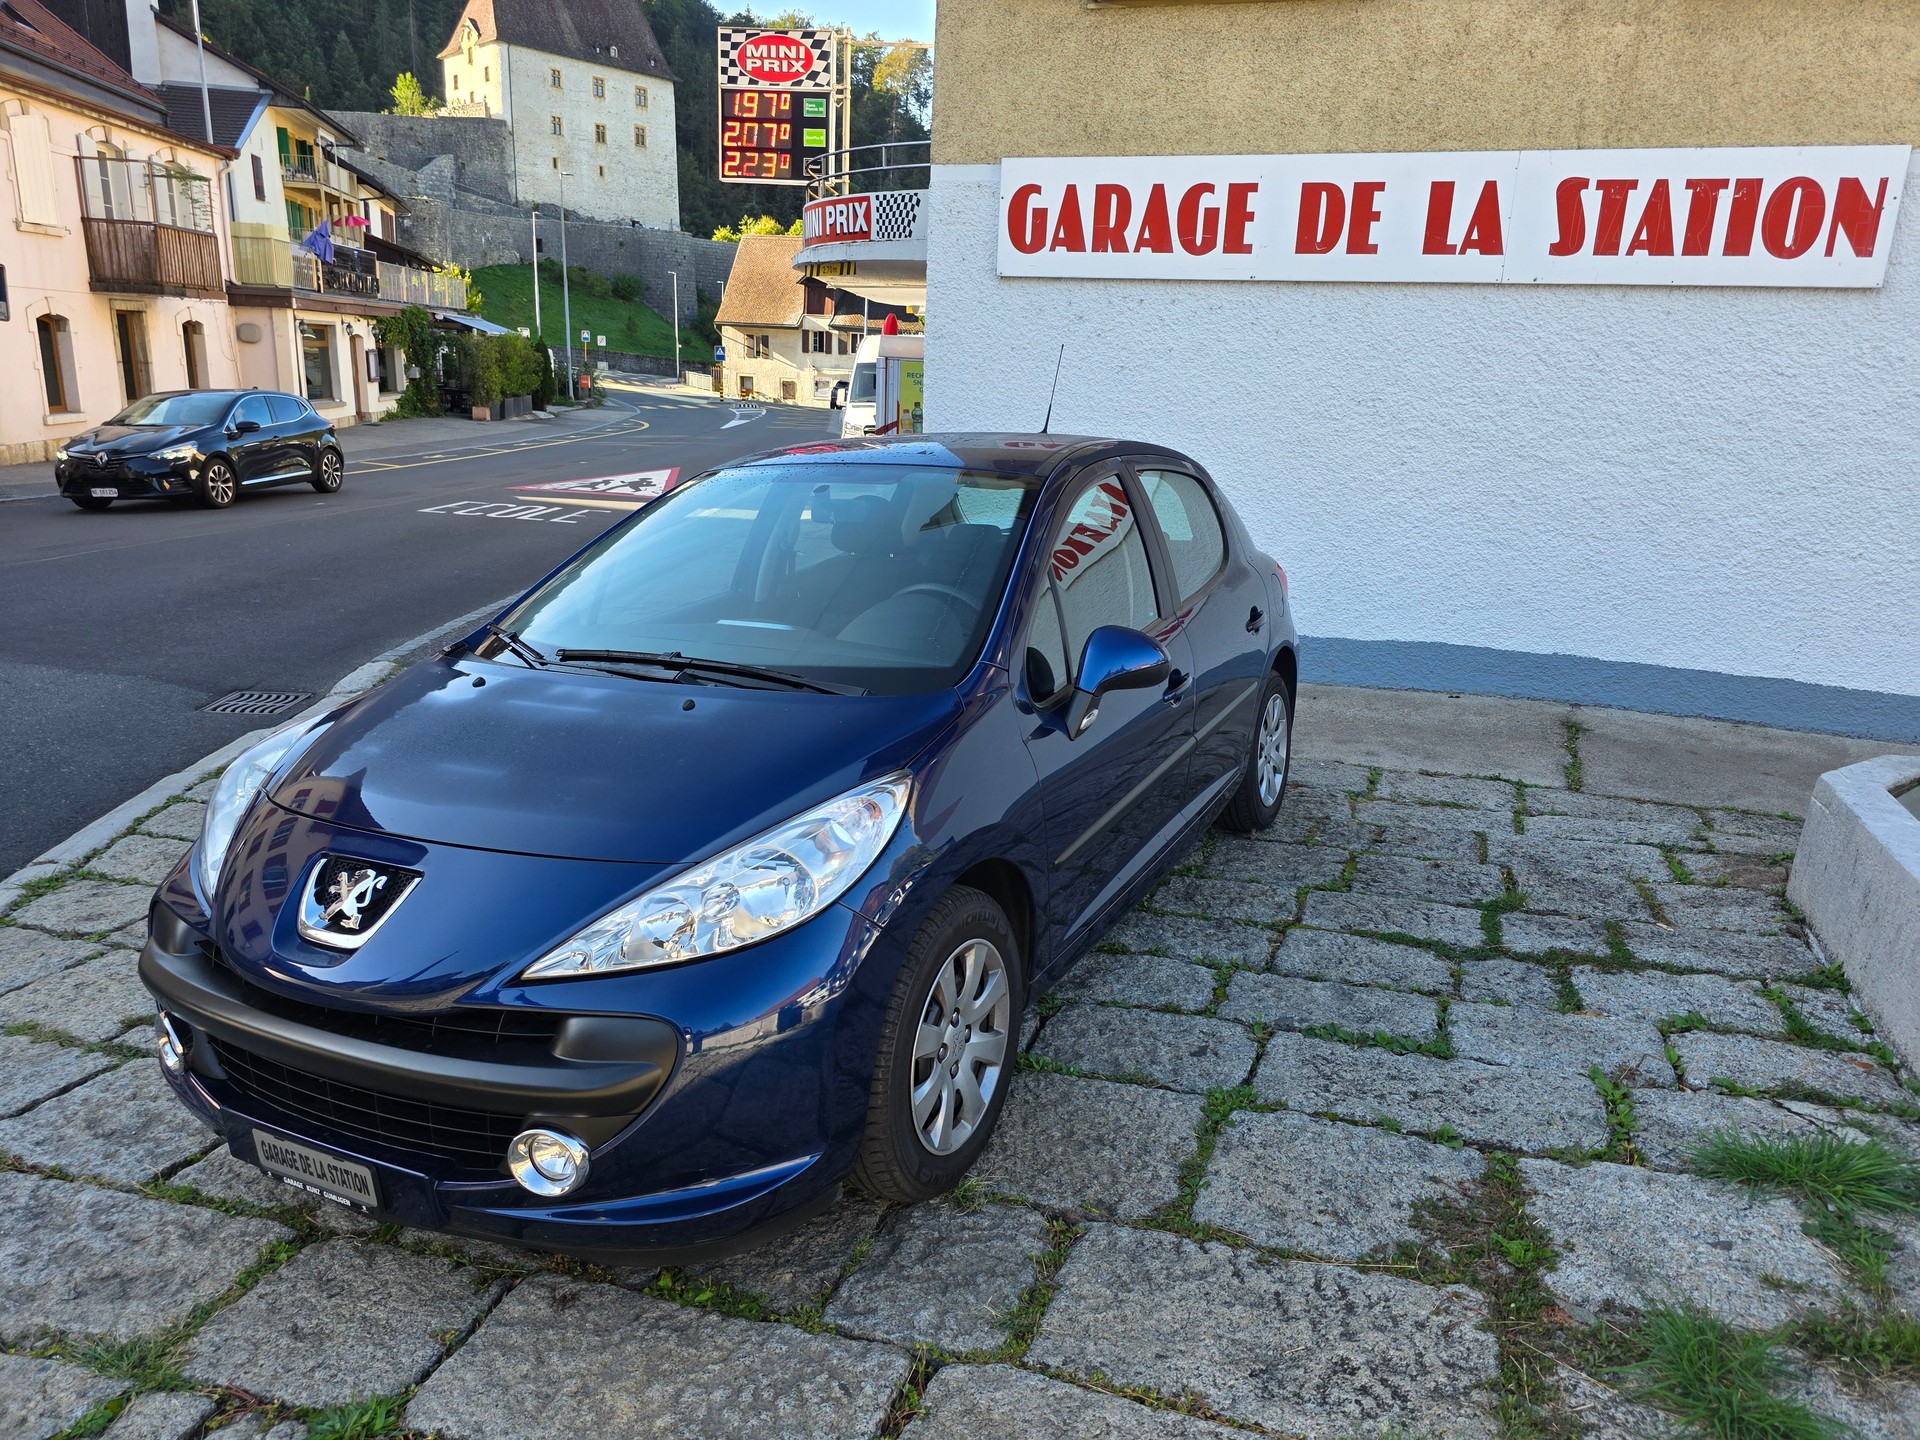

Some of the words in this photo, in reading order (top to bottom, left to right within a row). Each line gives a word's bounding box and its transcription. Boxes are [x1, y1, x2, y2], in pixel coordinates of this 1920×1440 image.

[745, 44, 806, 60] MINI
[745, 58, 806, 73] PRIX
[825, 201, 869, 237] PRIX
[1007, 182, 1259, 257] GARAGE
[1295, 181, 1386, 254] DE
[1421, 179, 1504, 256] LA
[1548, 175, 1890, 260] STATION
[417, 500, 612, 524] ECOLE
[260, 1140, 300, 1172] GARAGE
[299, 1153, 314, 1177] DE
[313, 1158, 328, 1181] LA
[327, 1163, 371, 1197] STATION
[283, 1176, 305, 1190] GARAGE
